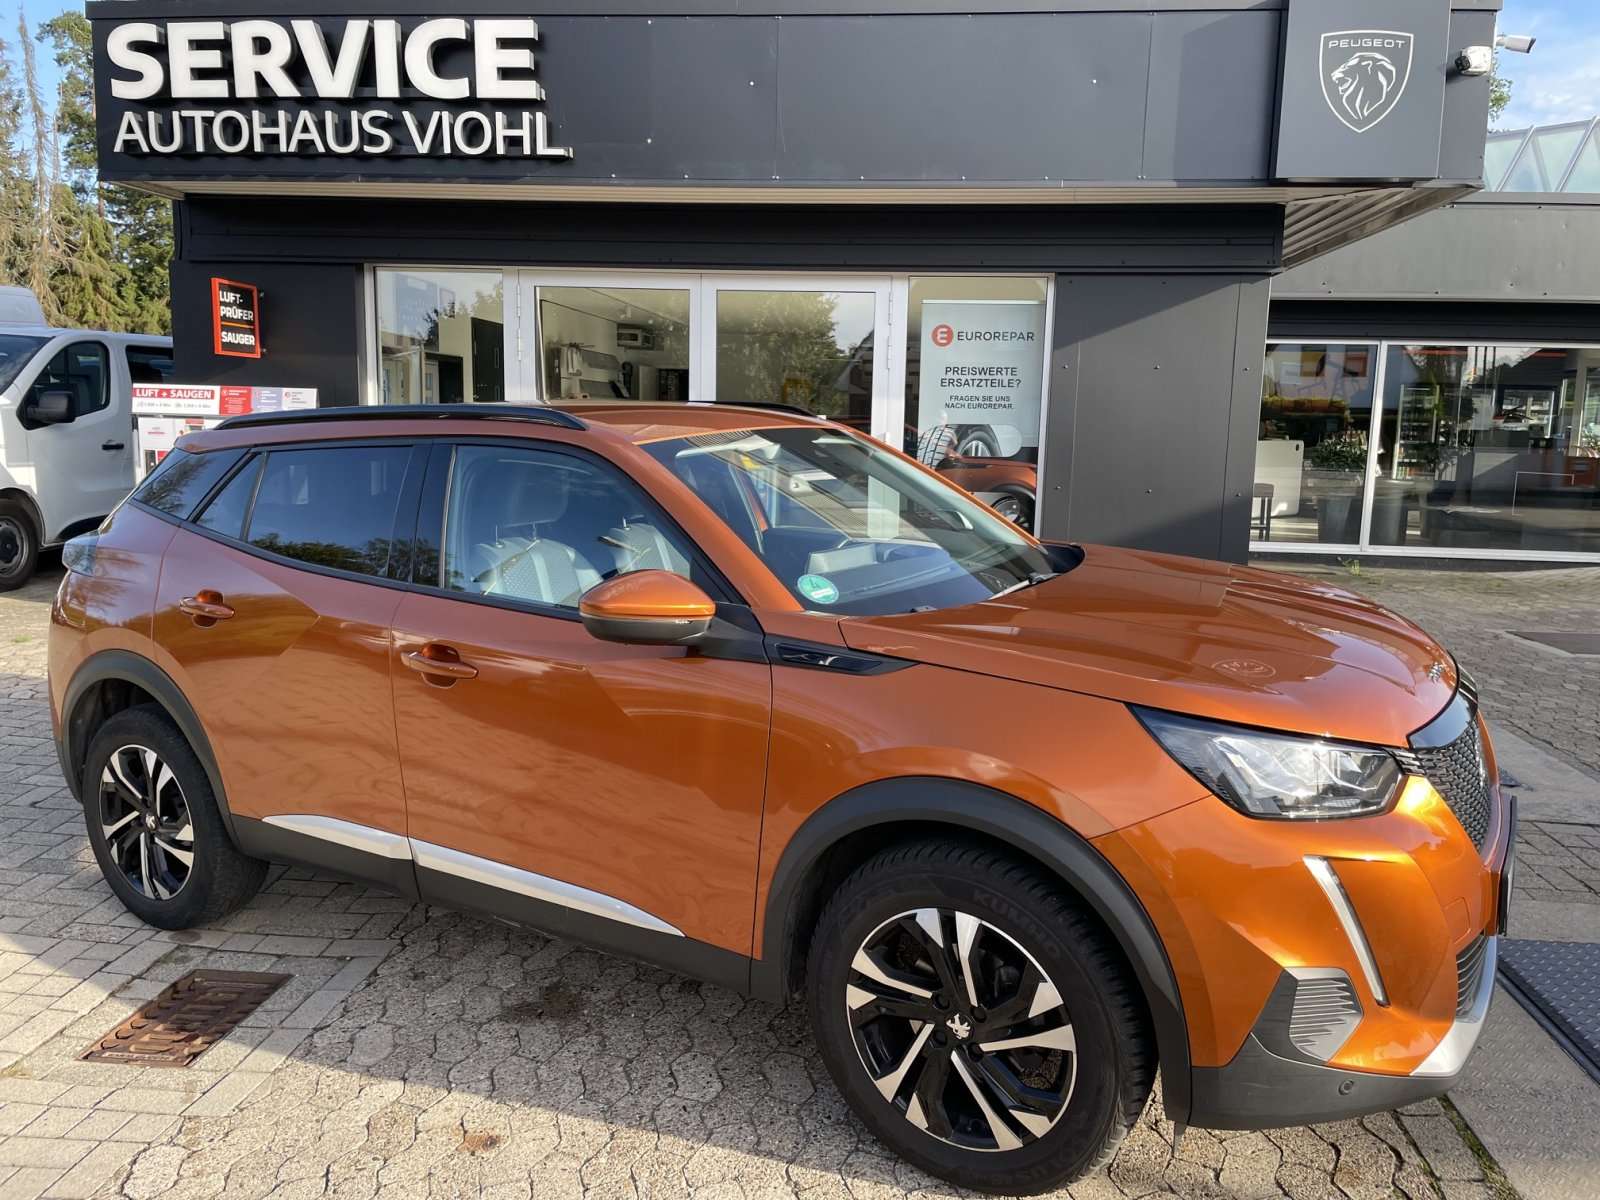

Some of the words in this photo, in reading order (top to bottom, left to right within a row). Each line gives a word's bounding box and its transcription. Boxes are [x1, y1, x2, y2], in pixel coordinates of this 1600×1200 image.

[1328, 38, 1406, 49] PEUGEOT
[106, 18, 544, 100] SERVICE
[113, 109, 393, 155] AUTOHAUS
[402, 110, 573, 158] VIOHL
[219, 290, 244, 304] LUFT-
[220, 304, 254, 321] PRÜFER
[221, 331, 256, 346] SAUGER
[957, 331, 1035, 342] EUROREPAR
[944, 366, 1018, 377] PREISWERTE
[940, 378, 1022, 388] ERSATZTEILE?
[135, 388, 160, 398] LUFT
[169, 389, 212, 399] SAUGEN
